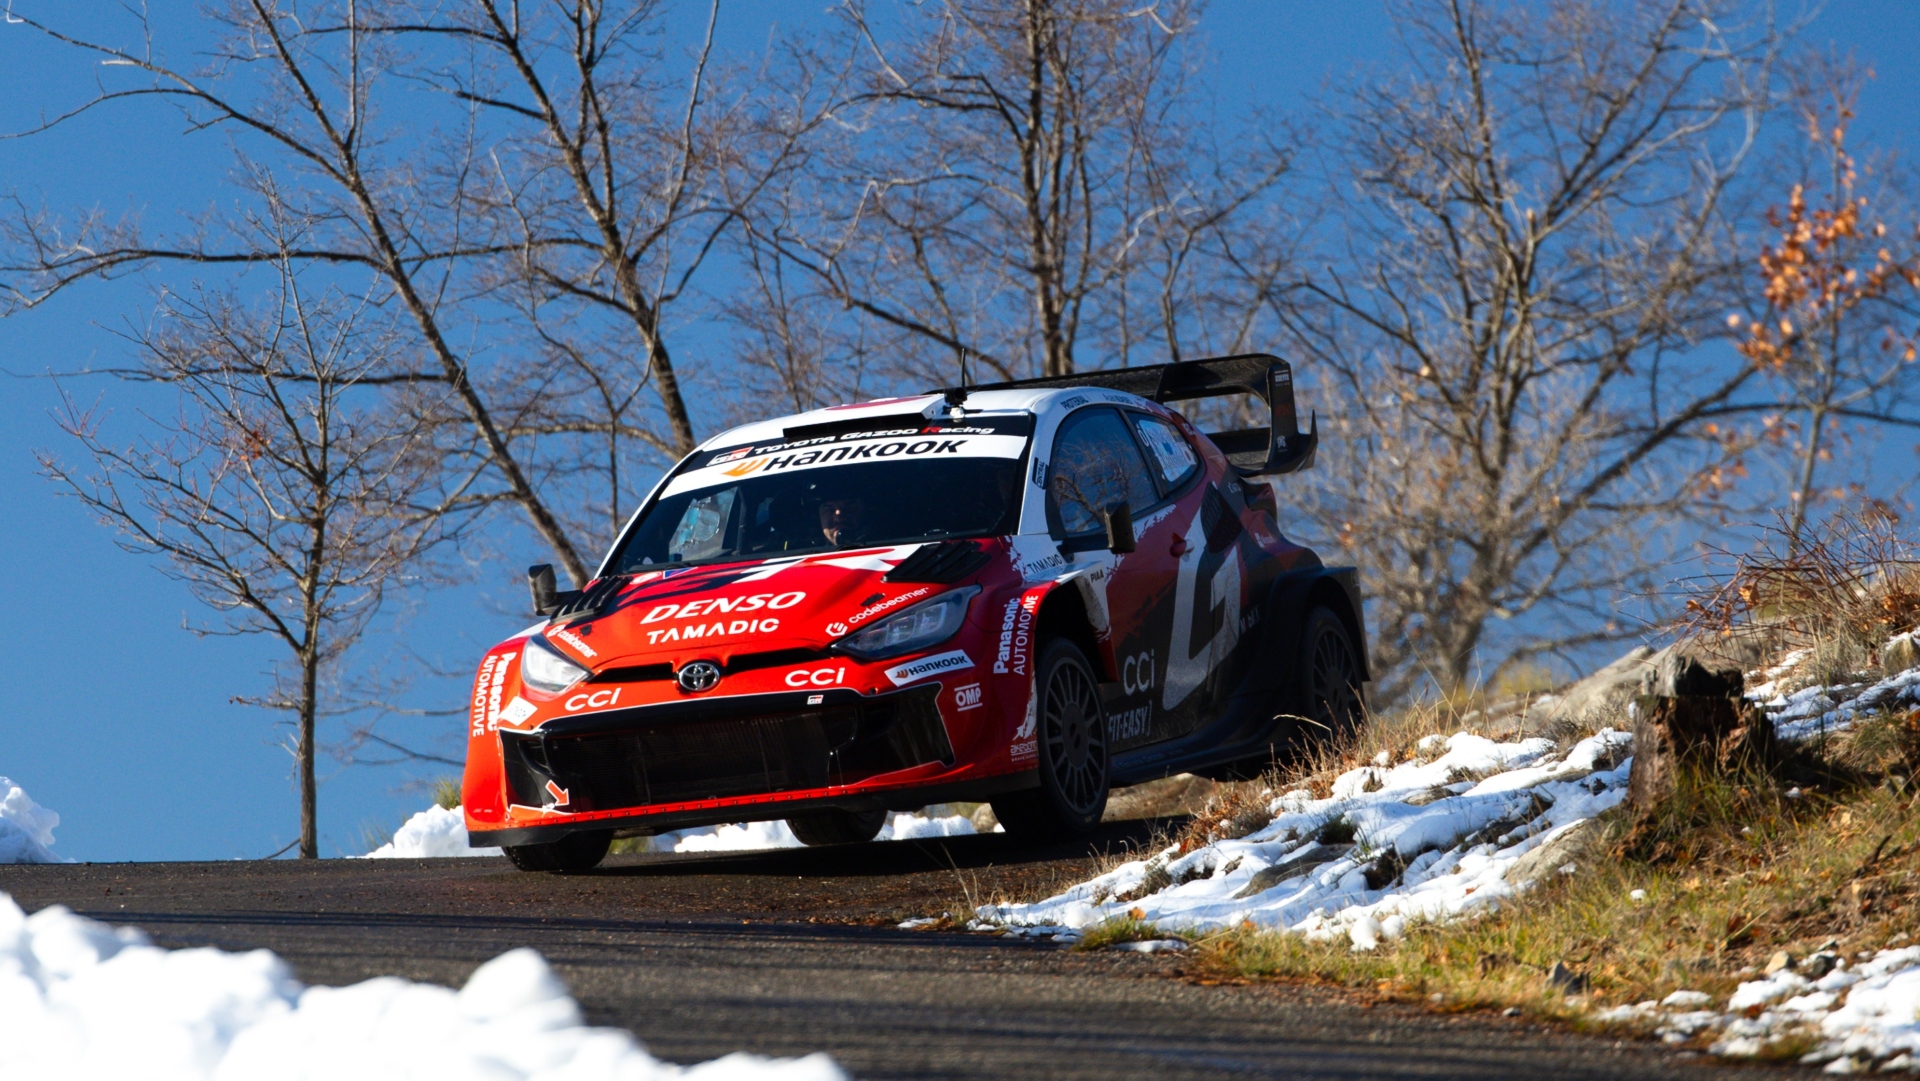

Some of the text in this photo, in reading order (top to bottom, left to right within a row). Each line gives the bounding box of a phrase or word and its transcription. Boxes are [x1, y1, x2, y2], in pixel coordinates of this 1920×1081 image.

[754, 435, 836, 454] TOYOTA
[840, 428, 918, 440] GAZOO
[922, 426, 996, 436] Racing
[1035, 461, 1045, 488] CENTRAL
[1026, 554, 1063, 574] TAMADIC
[1090, 568, 1105, 583] PIAA
[640, 591, 807, 625] DENSO
[848, 586, 928, 624] codebeamer
[557, 628, 598, 659] codebeamer
[646, 618, 780, 645] TAMADIC
[993, 597, 1021, 675] Panasonic
[1012, 594, 1039, 676] AUTOMOTIVE
[472, 654, 498, 738] AUTOMOTIVE
[487, 651, 517, 733] Panasonic
[955, 687, 982, 707] OMP
